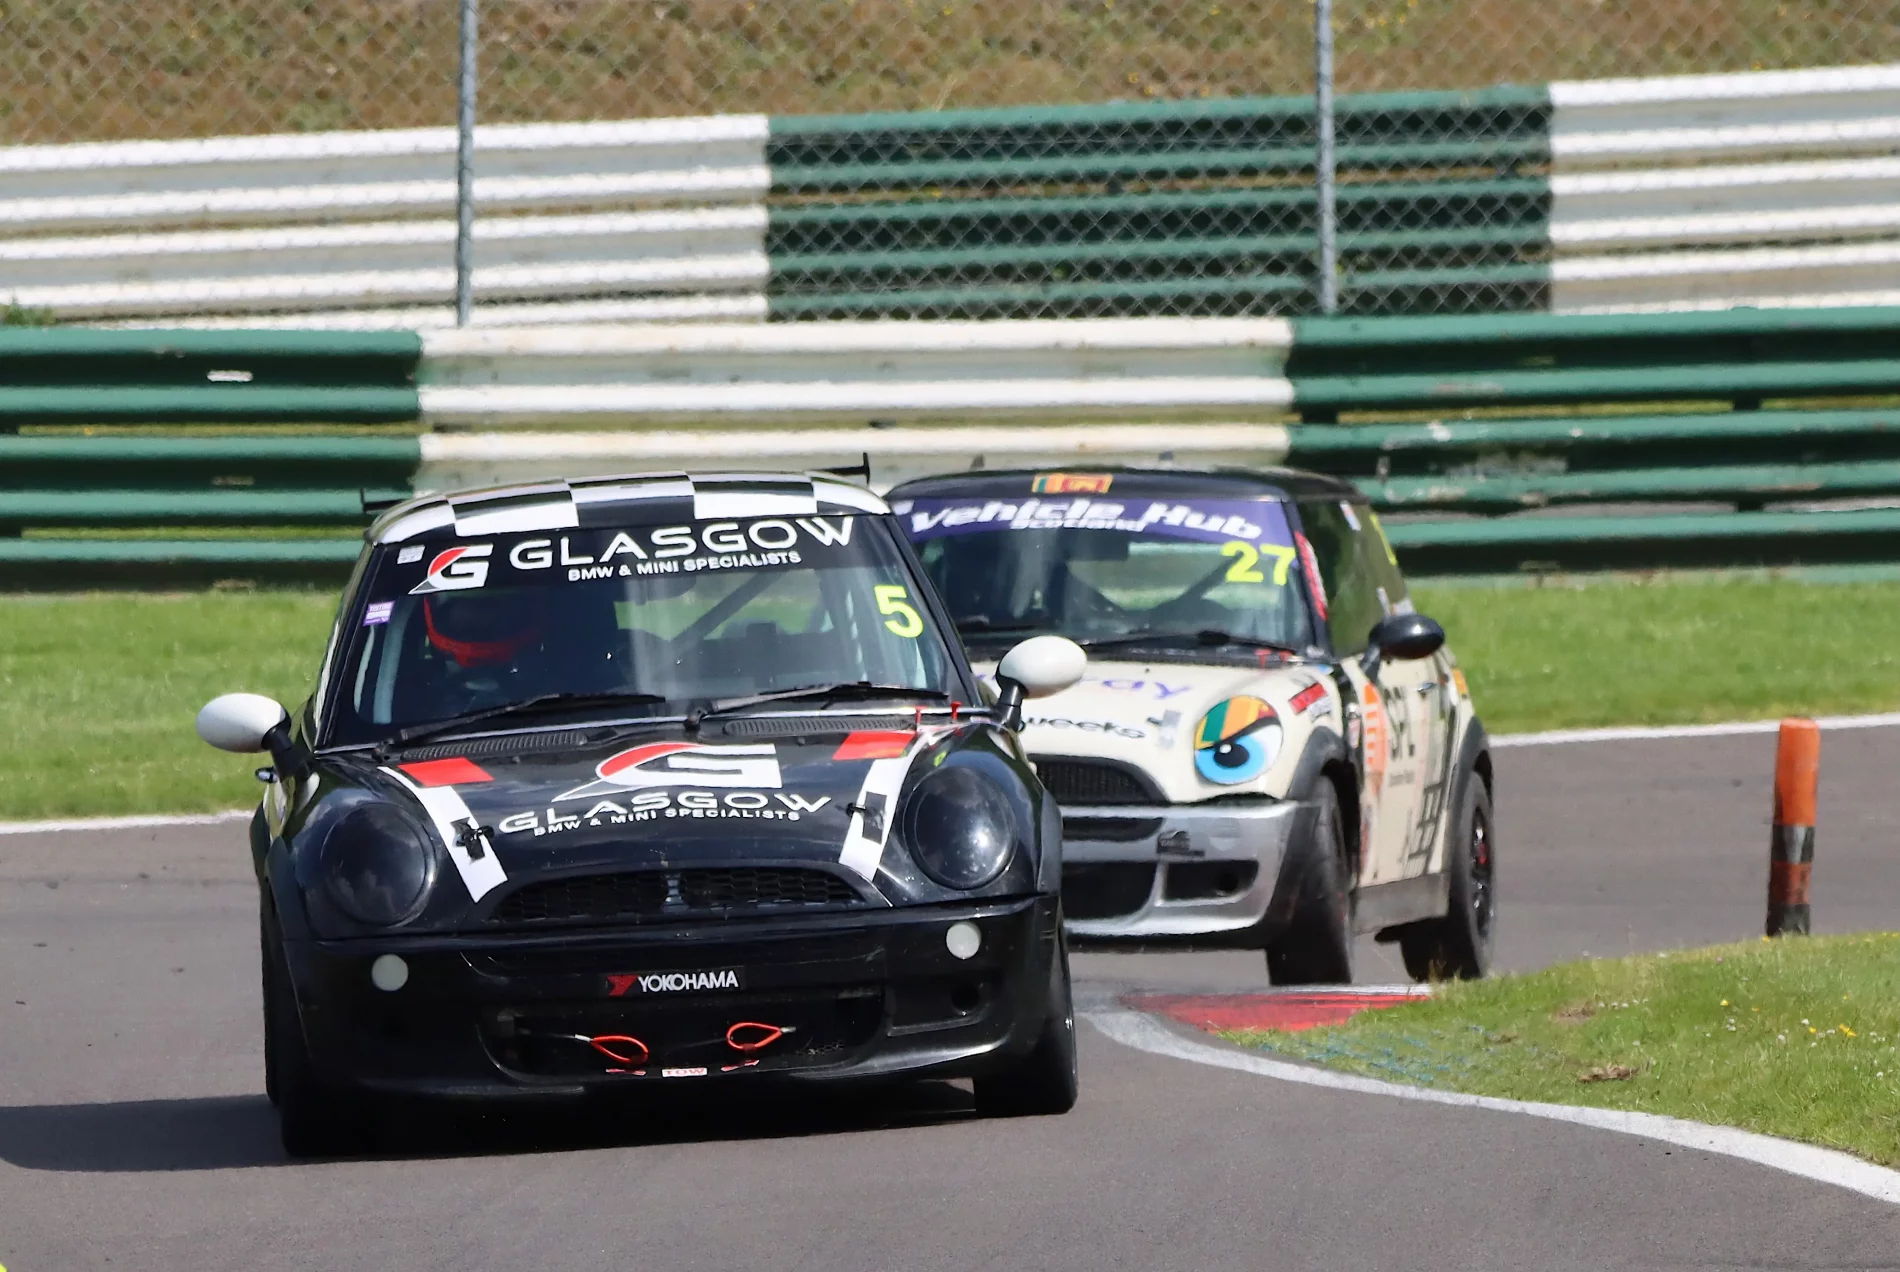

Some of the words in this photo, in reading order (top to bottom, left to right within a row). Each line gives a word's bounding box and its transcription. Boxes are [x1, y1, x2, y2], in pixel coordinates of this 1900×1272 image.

[1145, 502, 1262, 540] Hub
[509, 516, 854, 569] GLASGOW
[568, 565, 613, 582] BMW
[617, 565, 631, 577] &
[636, 562, 679, 576] MINI
[683, 550, 802, 572] SPECIALISTS
[1220, 540, 1297, 586] 27
[874, 584, 924, 638] 5
[498, 791, 832, 834] GLASGOW
[533, 820, 582, 837] BMW
[589, 817, 602, 828] &
[610, 810, 657, 825] MINI
[664, 807, 801, 822] SPECIALISTS
[638, 970, 739, 993] YOKOHAMA
[664, 1067, 707, 1077] TOW
